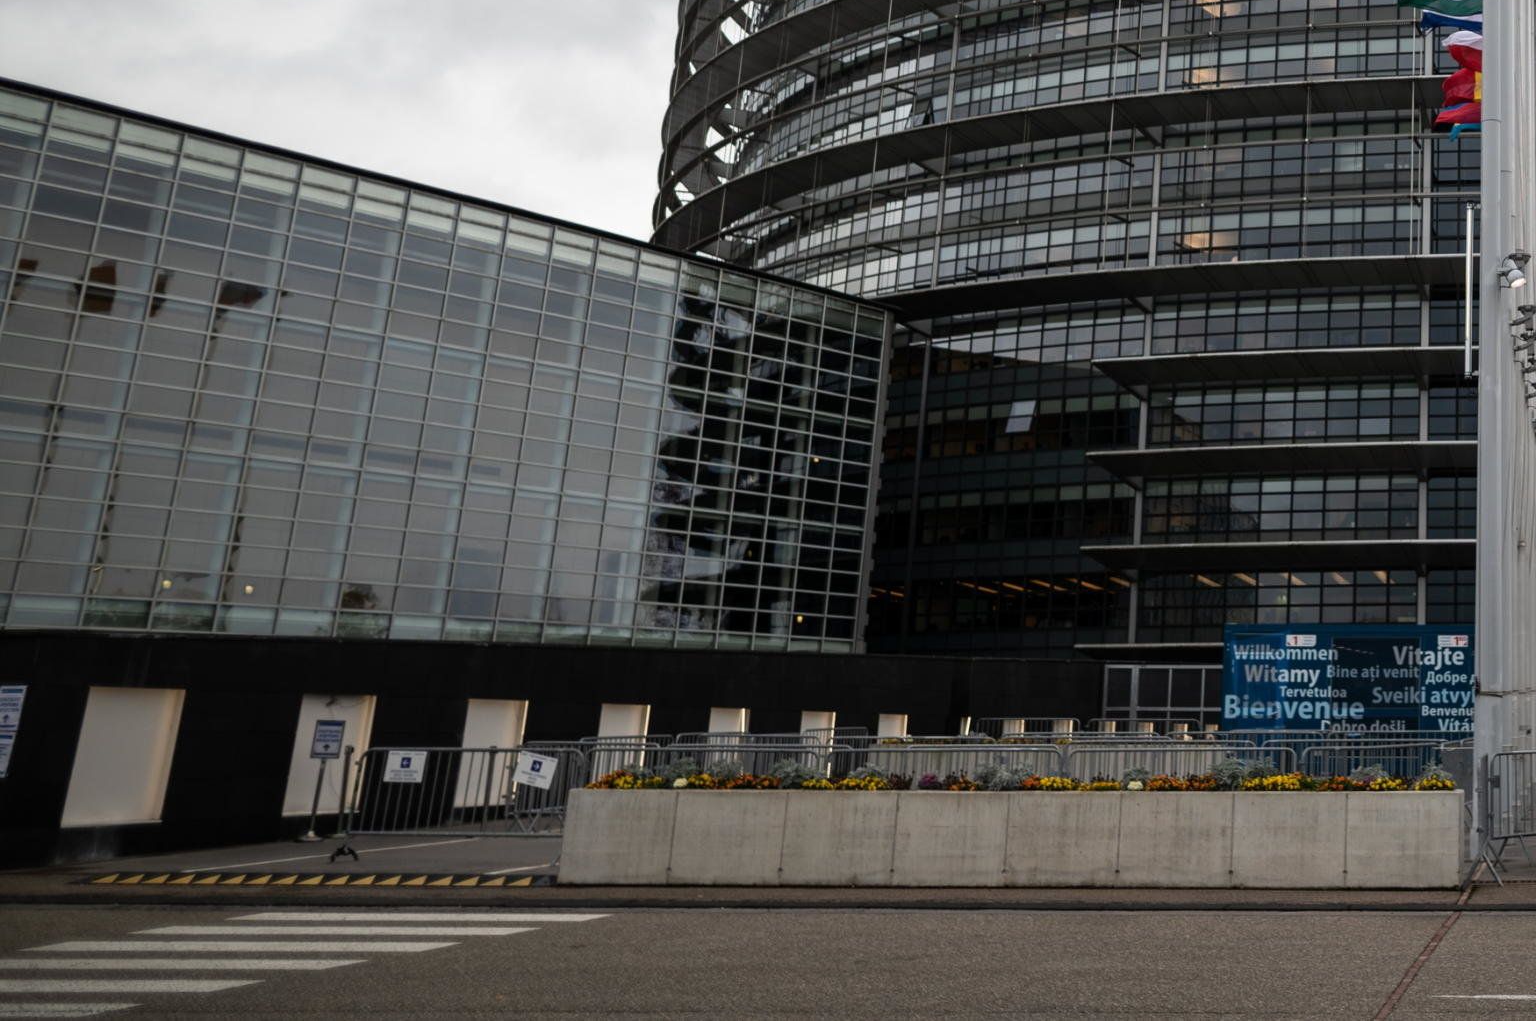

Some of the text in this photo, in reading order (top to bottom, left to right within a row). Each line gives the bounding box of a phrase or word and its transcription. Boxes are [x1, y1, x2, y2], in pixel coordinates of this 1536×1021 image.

[1233, 644, 1339, 661] Willkommen
[1392, 645, 1465, 671] Vitajte
[1244, 664, 1321, 688] Witamy
[1326, 665, 1358, 679] Bine
[1383, 665, 1420, 678] venit
[1425, 671, 1467, 686] Добре
[1279, 685, 1348, 698] Tervetuloa
[1372, 686, 1427, 704] Sveiki
[1224, 694, 1365, 720] Bienvenue
[1421, 705, 1475, 717] Benvenu
[1320, 720, 1406, 732] Dobro došli
